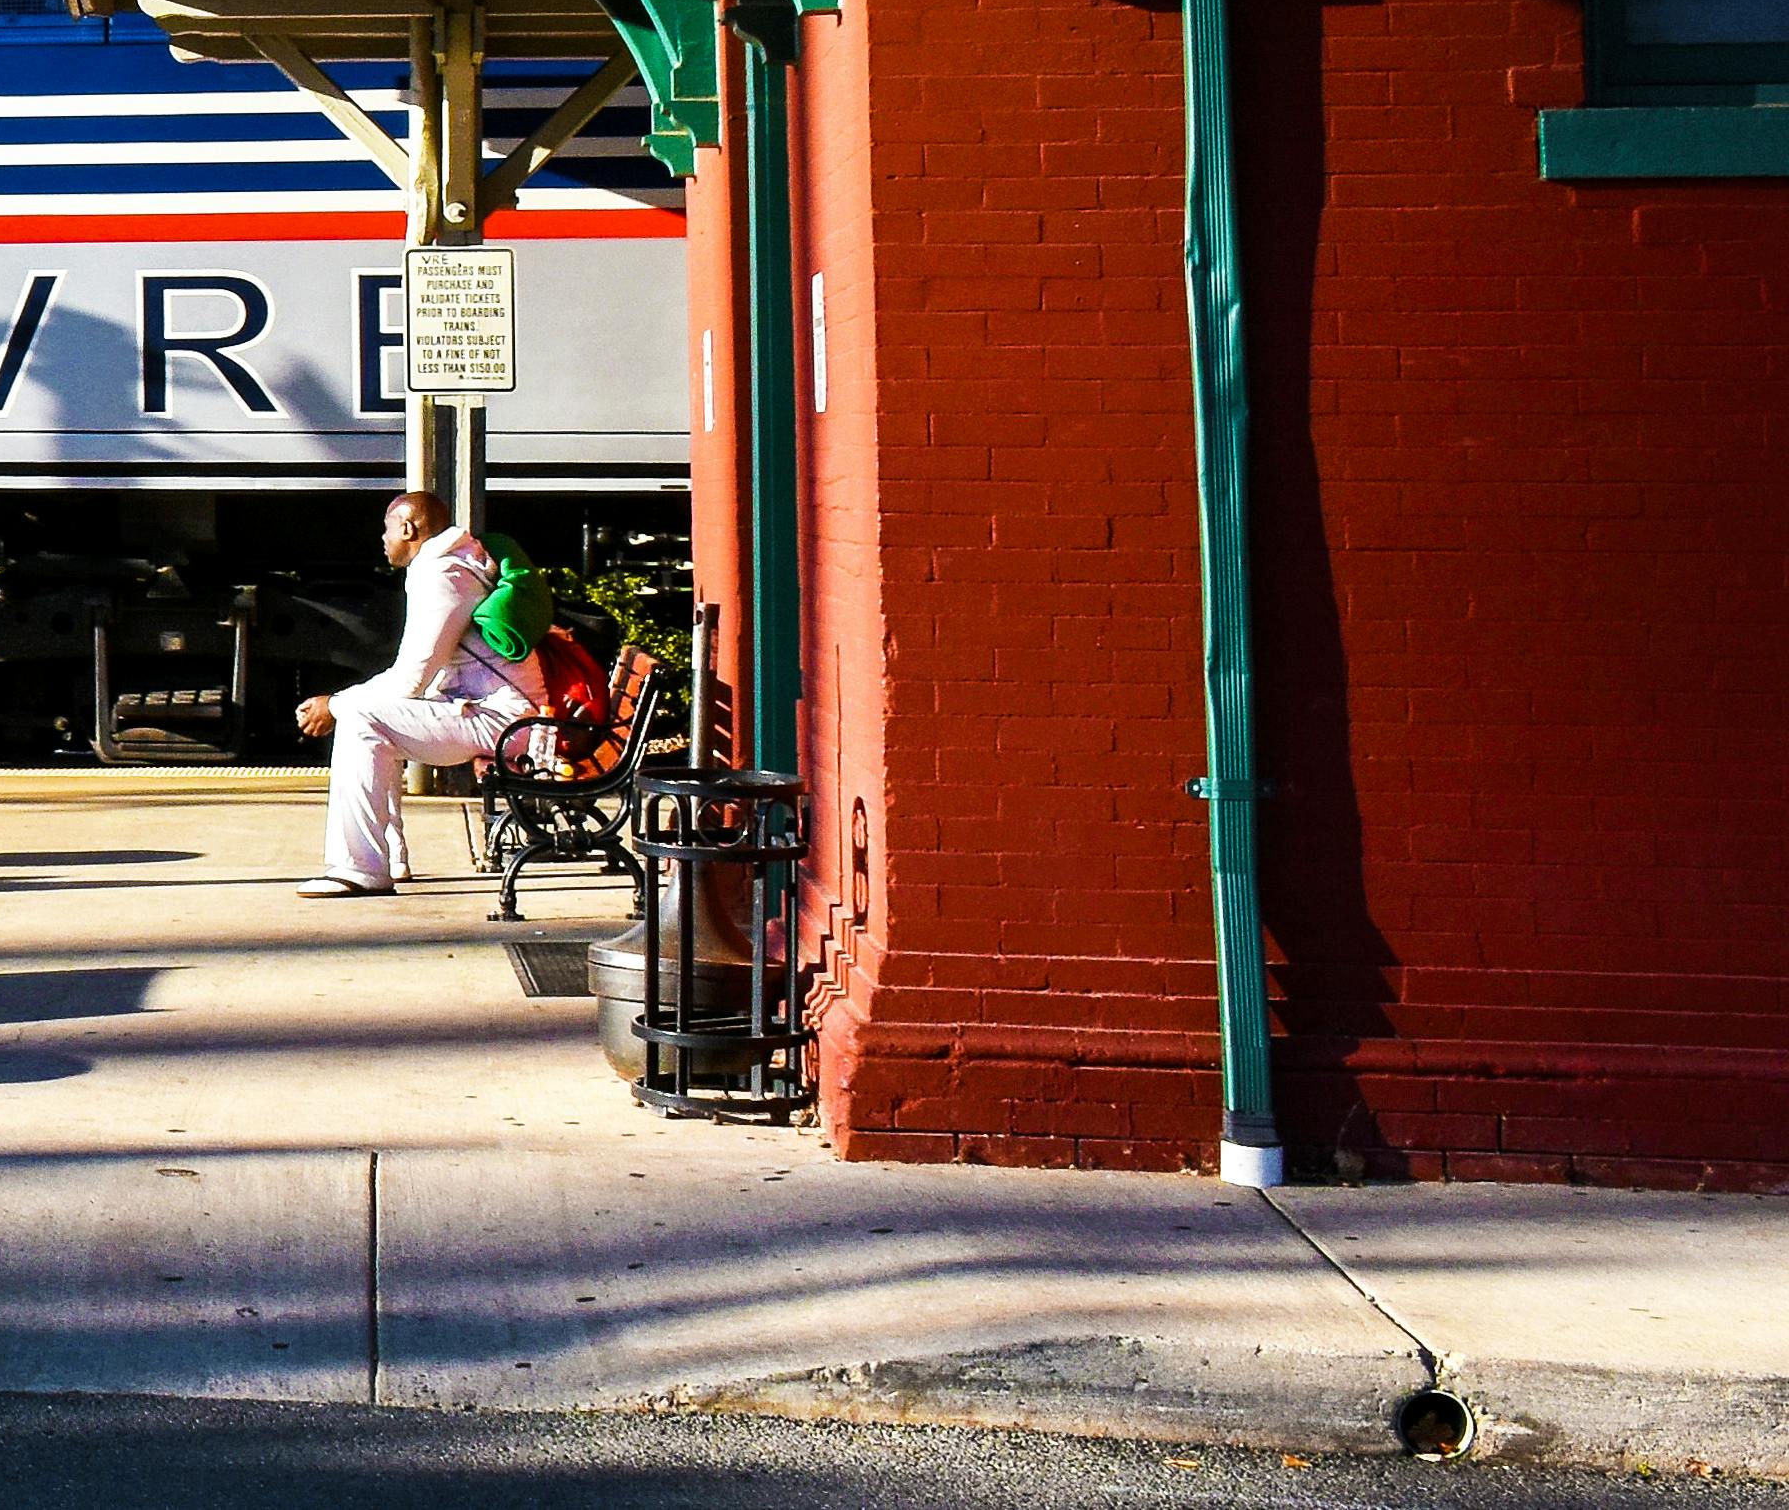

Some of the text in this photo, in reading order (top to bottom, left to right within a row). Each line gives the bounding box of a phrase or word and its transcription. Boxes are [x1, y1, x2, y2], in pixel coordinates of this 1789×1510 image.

[422, 254, 449, 265] VRE
[417, 265, 502, 276] PASSENGERS MUST
[427, 279, 494, 290] PURCHASE AND
[421, 293, 501, 304] VALIDATE TICKETS
[416, 307, 505, 318] PRIOR TO BOARDING
[416, 335, 506, 346] VIOLATORS SUBJECT
[422, 349, 501, 359] TO A FINE OF NOT
[417, 363, 506, 374] LESS THAN $150.00
